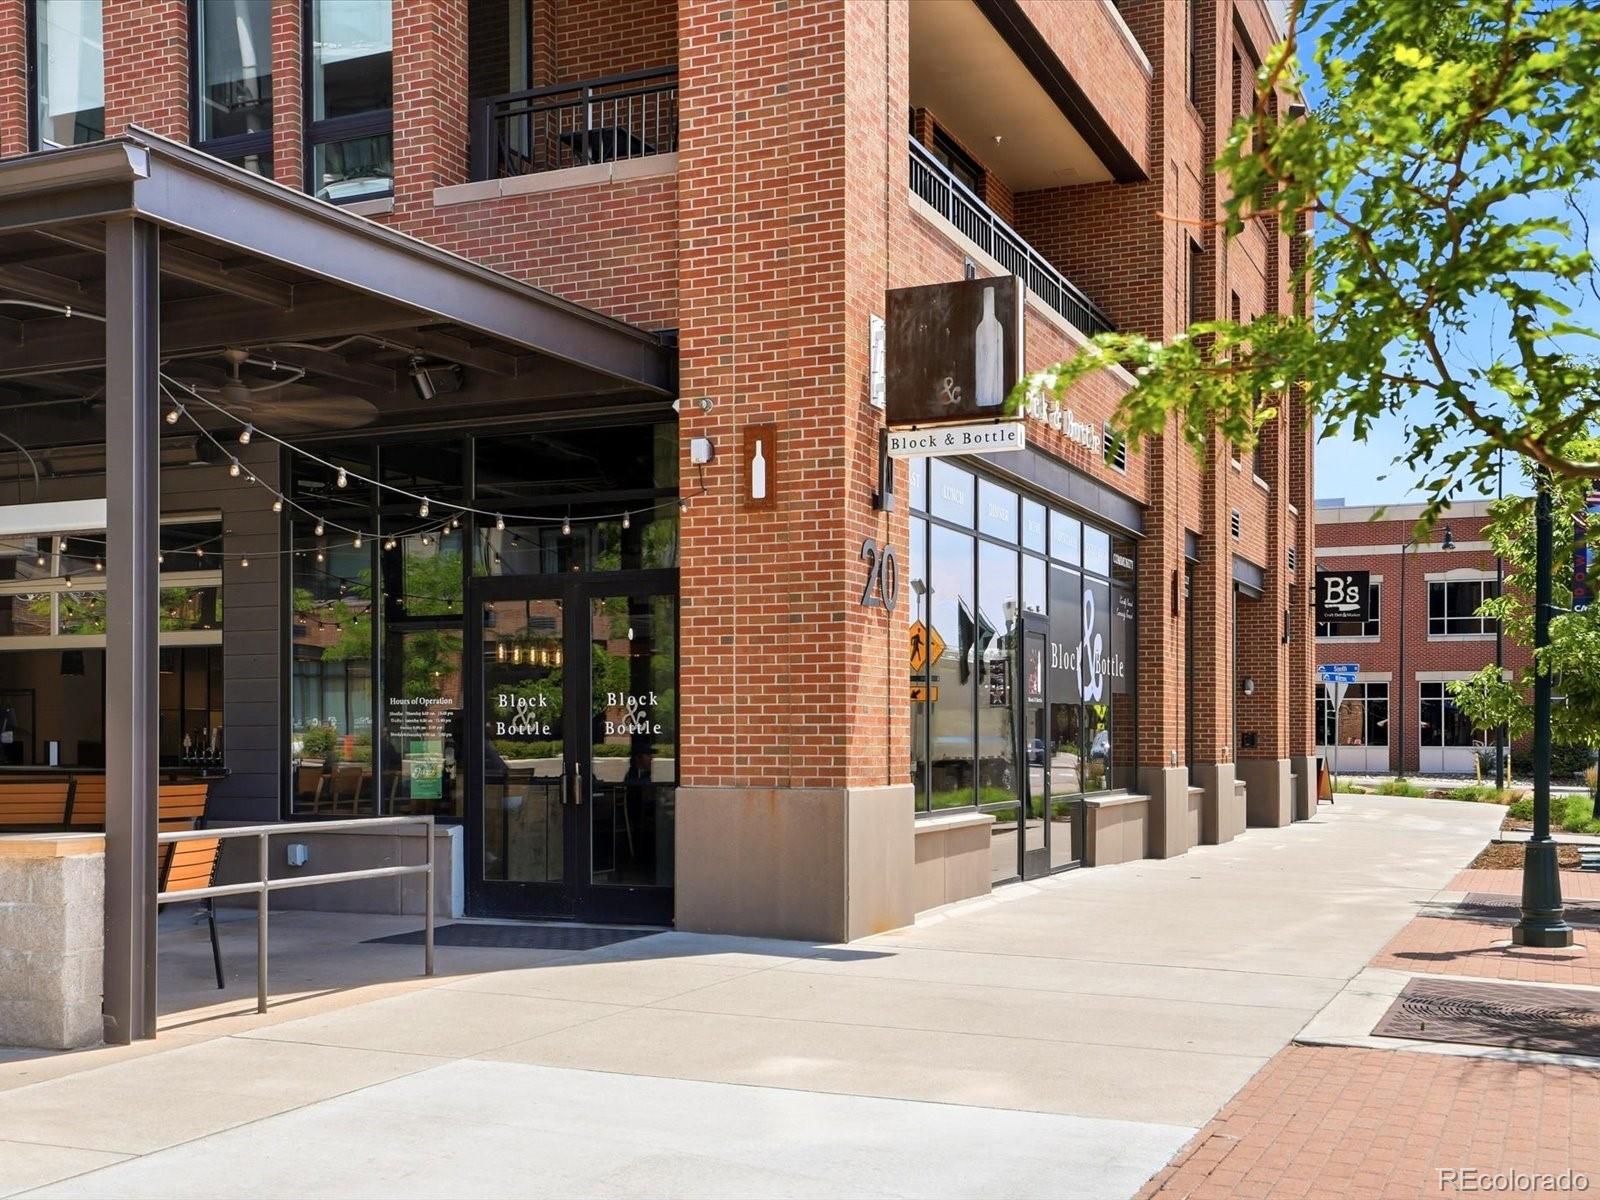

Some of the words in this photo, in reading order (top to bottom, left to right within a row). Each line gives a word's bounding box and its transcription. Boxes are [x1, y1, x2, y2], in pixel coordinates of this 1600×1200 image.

[940, 376, 961, 405] &
[891, 435, 937, 450] Block
[945, 433, 954, 445] &
[963, 430, 1016, 444] Bottle
[861, 538, 900, 612] 20
[1324, 576, 1360, 604] B's
[1095, 650, 1124, 678] Bottle
[390, 697, 410, 705] Hours
[411, 697, 419, 705] of
[419, 697, 453, 706] Operation
[498, 693, 547, 707] Block
[607, 691, 658, 706] Block
[496, 721, 552, 735] Bottle
[604, 720, 663, 735] Bottle
